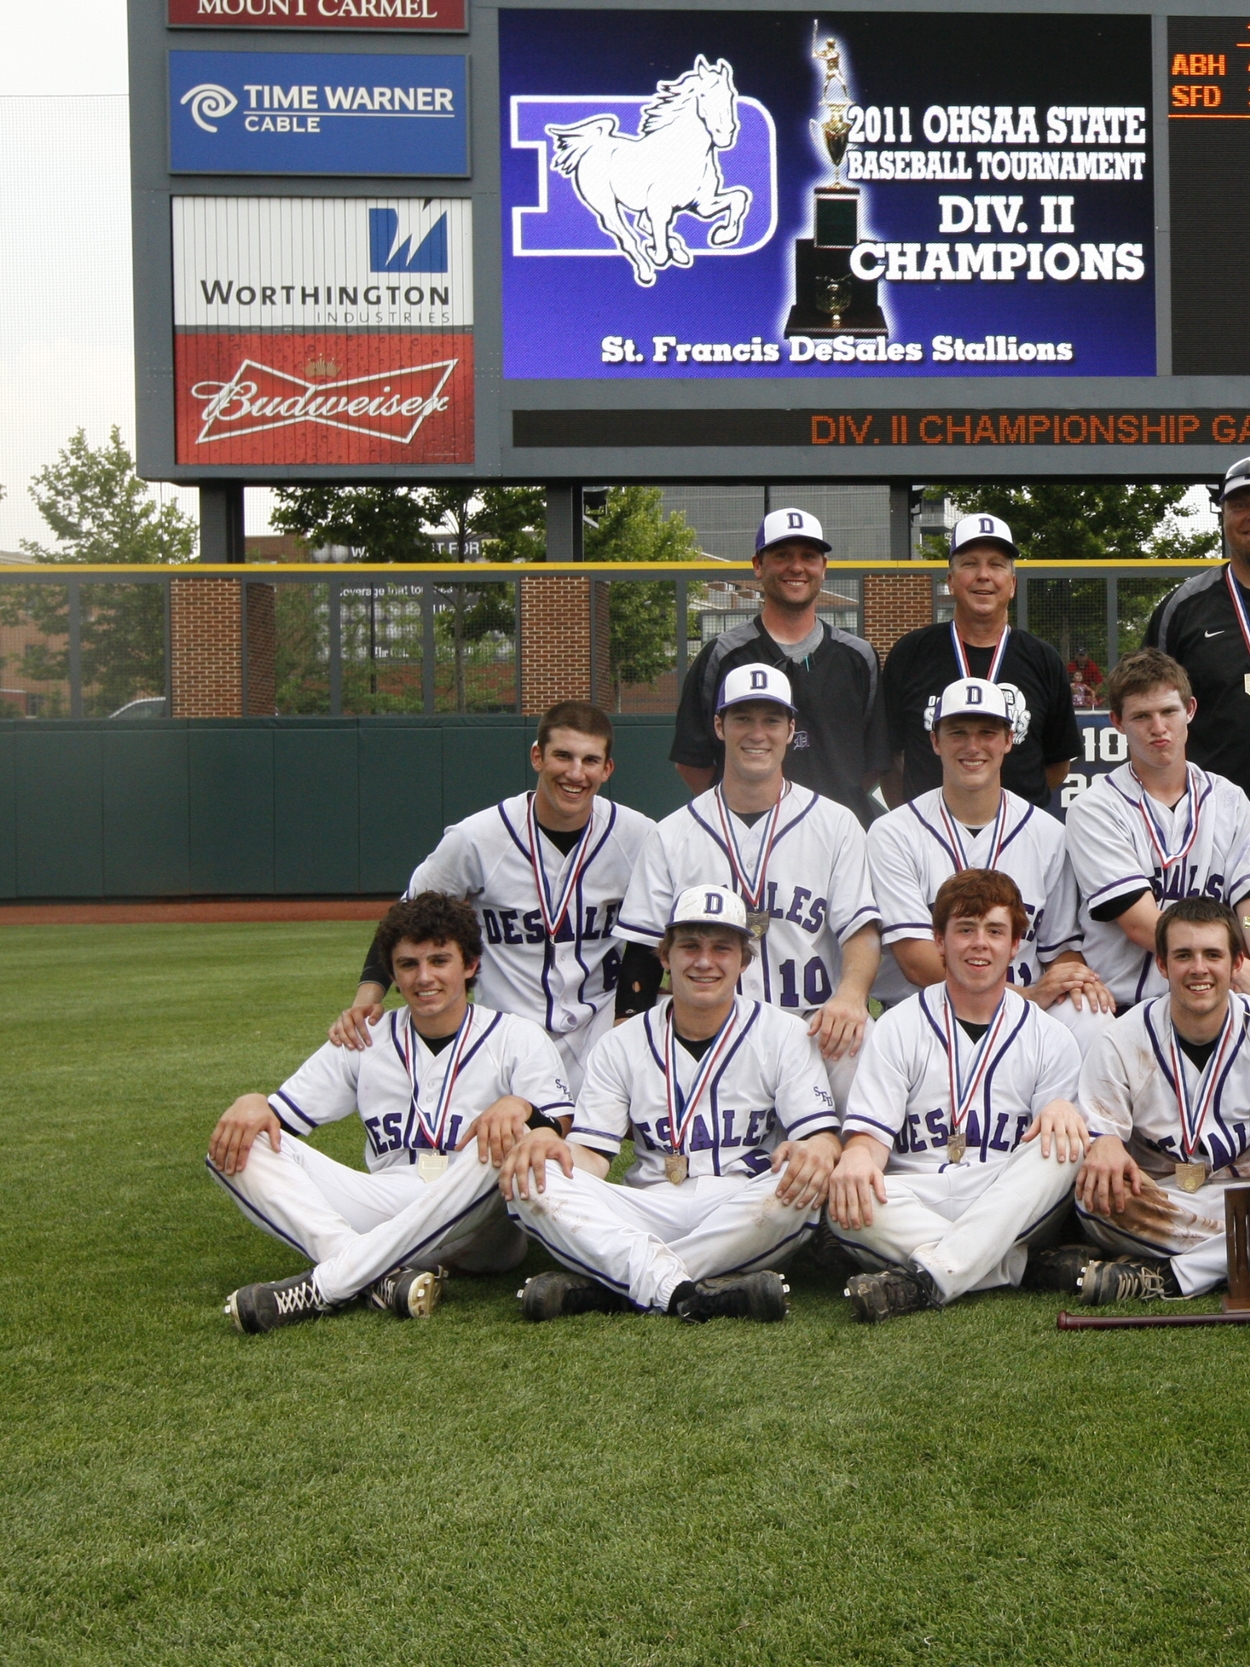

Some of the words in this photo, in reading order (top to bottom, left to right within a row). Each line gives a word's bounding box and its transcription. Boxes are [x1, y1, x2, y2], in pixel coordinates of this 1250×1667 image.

[197, 0, 307, 15] MOUNT
[318, 0, 438, 18] CARMEL
[1172, 54, 1226, 76] ABH
[244, 85, 319, 109] TIME
[324, 86, 454, 111] WARNER
[1172, 86, 1222, 107] SFD
[245, 116, 320, 132] CABLE
[848, 106, 912, 143] 2011
[922, 105, 1040, 143] OHSAA
[1046, 106, 1146, 144] STATE
[848, 150, 972, 180] BASEBALL
[976, 151, 1146, 181] TOURNAMENT
[938, 195, 1028, 233] DIV.
[1040, 196, 1075, 233] II
[849, 242, 1145, 281] CHAMPIONS
[317, 311, 451, 324] INDUSTRIES
[601, 335, 644, 362] St.
[652, 336, 780, 362] Francis
[788, 335, 923, 362] DeSales
[931, 335, 1073, 361] Stallions
[191, 381, 450, 421] Budweiser
[811, 415, 880, 444] DIV.
[891, 415, 908, 444] II
[919, 415, 1200, 444] CHAMPIONSHIP
[787, 512, 804, 529] D
[979, 517, 995, 534] D
[749, 670, 767, 690] D
[965, 685, 983, 705] D
[704, 891, 724, 915] D
[779, 956, 833, 1008] 10
